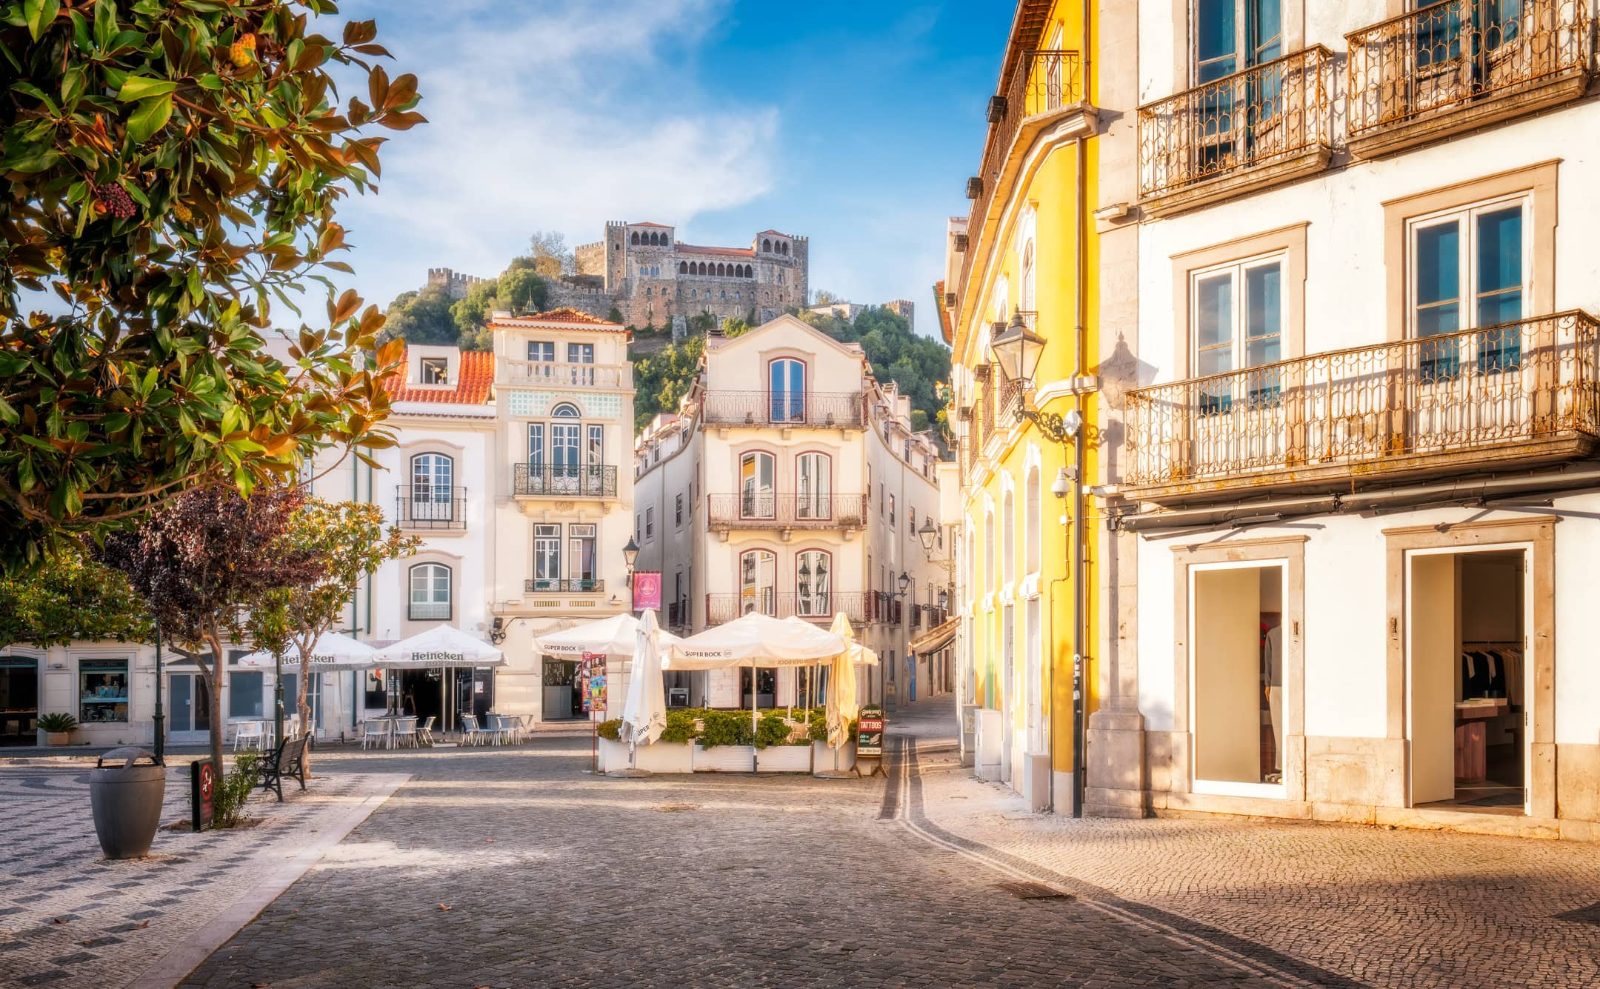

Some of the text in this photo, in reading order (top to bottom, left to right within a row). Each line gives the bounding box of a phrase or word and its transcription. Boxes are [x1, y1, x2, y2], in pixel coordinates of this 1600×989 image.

[411, 651, 464, 661] Heineken
[684, 650, 703, 658] SUPER
[281, 654, 335, 665] Heieken
